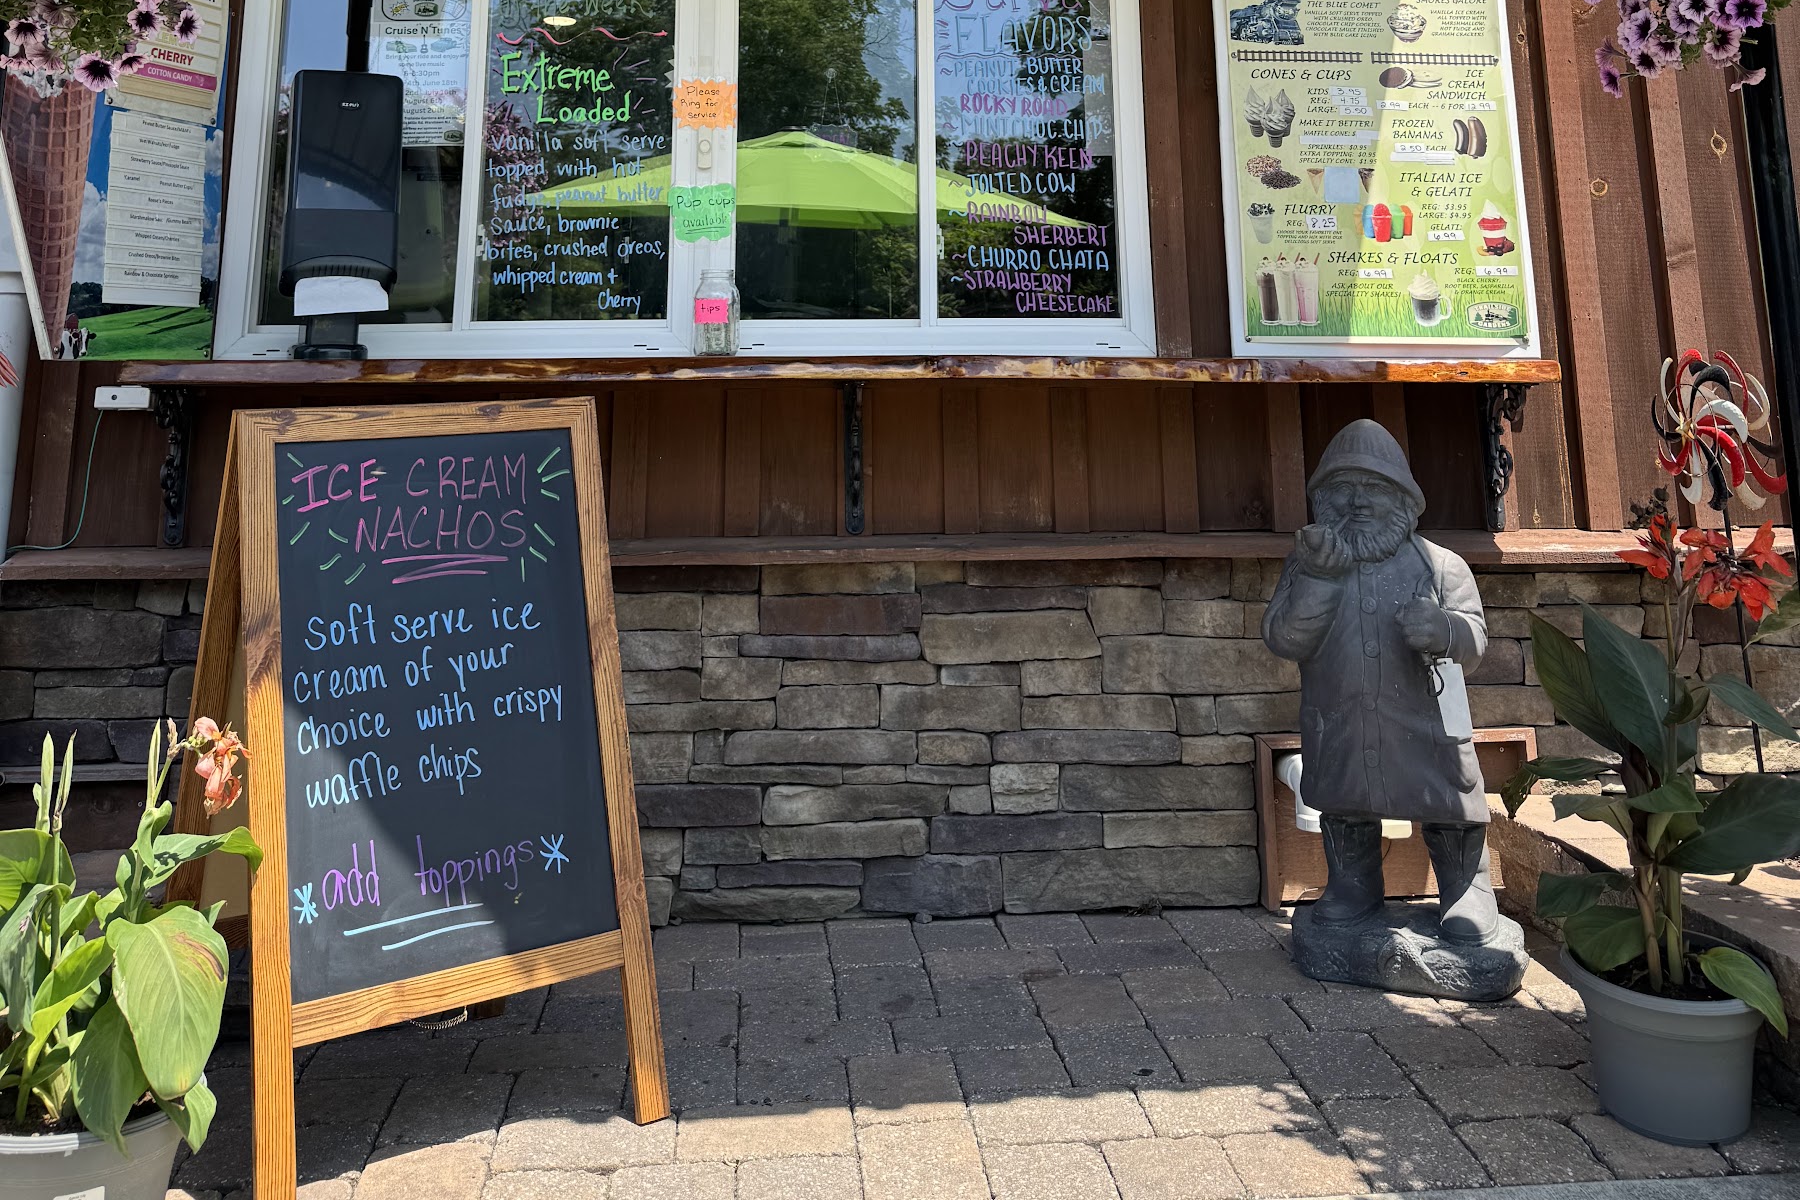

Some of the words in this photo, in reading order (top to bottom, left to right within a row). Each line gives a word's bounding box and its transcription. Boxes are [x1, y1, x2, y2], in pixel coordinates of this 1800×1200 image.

[1350, 1, 1381, 9] COMET
[385, 26, 418, 34] Cruise
[954, 12, 1093, 55] FLAVORS
[150, 47, 194, 66] CHERRY
[954, 60, 1018, 78] PEANUT
[1026, 56, 1084, 75] BUTTER
[148, 66, 172, 78] COTTON
[172, 72, 193, 82] CANDY
[501, 51, 616, 95] Extreme
[1251, 68, 1296, 80] CONES
[1300, 70, 1311, 80] &
[1316, 70, 1352, 81] CUPS
[1466, 70, 1484, 78] ICE
[686, 86, 720, 96] Please
[966, 76, 1034, 96] COOKIES
[1050, 74, 1106, 96] CREAM
[1427, 91, 1486, 100] SANDWICH
[1448, 80, 1485, 89] CREAM
[536, 90, 632, 125] Loaded
[680, 99, 700, 109] Ring
[706, 98, 718, 107] for
[960, 93, 1016, 116] ROCKY
[1020, 96, 1068, 117] ROAD
[1064, 117, 1103, 141] CHIP
[1392, 120, 1434, 128] FROZEN
[1393, 131, 1443, 139] BANANAS
[573, 130, 609, 154] soft
[620, 134, 667, 150] serve
[965, 140, 1038, 168] PEACHY
[1044, 144, 1093, 170] KEEN
[485, 158, 546, 183] topped
[557, 158, 598, 178] with
[612, 156, 645, 178] hot
[1400, 172, 1455, 183] ITALIAN
[1459, 174, 1482, 183] ICE
[965, 172, 1033, 197] JOLTED
[1037, 172, 1076, 194] COW
[1412, 187, 1421, 197] &
[1426, 187, 1473, 197] GELATI
[555, 186, 608, 210] peanut
[617, 182, 664, 202] butter
[676, 196, 702, 210] Pup
[708, 197, 735, 208] cups
[966, 202, 1048, 224] RAINBOW
[1284, 204, 1336, 215] FLURRY
[558, 214, 620, 234] brownie
[1311, 218, 1336, 228] 8.25
[1014, 224, 1108, 247] SHERBERT
[1434, 232, 1457, 240] 6.99
[544, 236, 609, 258] crushed
[967, 244, 1040, 270] CHURRO
[1048, 249, 1110, 272] CHATA
[1327, 252, 1383, 263] SHAKES
[1388, 252, 1399, 264] &
[1404, 252, 1458, 265] FLOATS
[493, 262, 556, 294] whipped
[559, 272, 604, 286] cream
[964, 270, 1072, 293] STRAWBERRY
[1484, 268, 1508, 276] 6.99
[701, 304, 720, 314] tips
[1015, 292, 1116, 314] CHEESECAKE
[292, 459, 379, 512] ICE
[406, 453, 526, 504] CREAM
[355, 505, 527, 552] NACHOS
[304, 603, 376, 651] Soft
[390, 608, 473, 644] serve
[492, 598, 542, 630] ice
[404, 646, 433, 687] of
[448, 642, 514, 692] your
[297, 708, 391, 755] choice
[416, 692, 476, 732] with
[494, 685, 564, 722] crispy
[306, 751, 402, 808] waffle
[418, 744, 482, 796] chips
[322, 839, 381, 910] add
[414, 834, 534, 907] toppings
